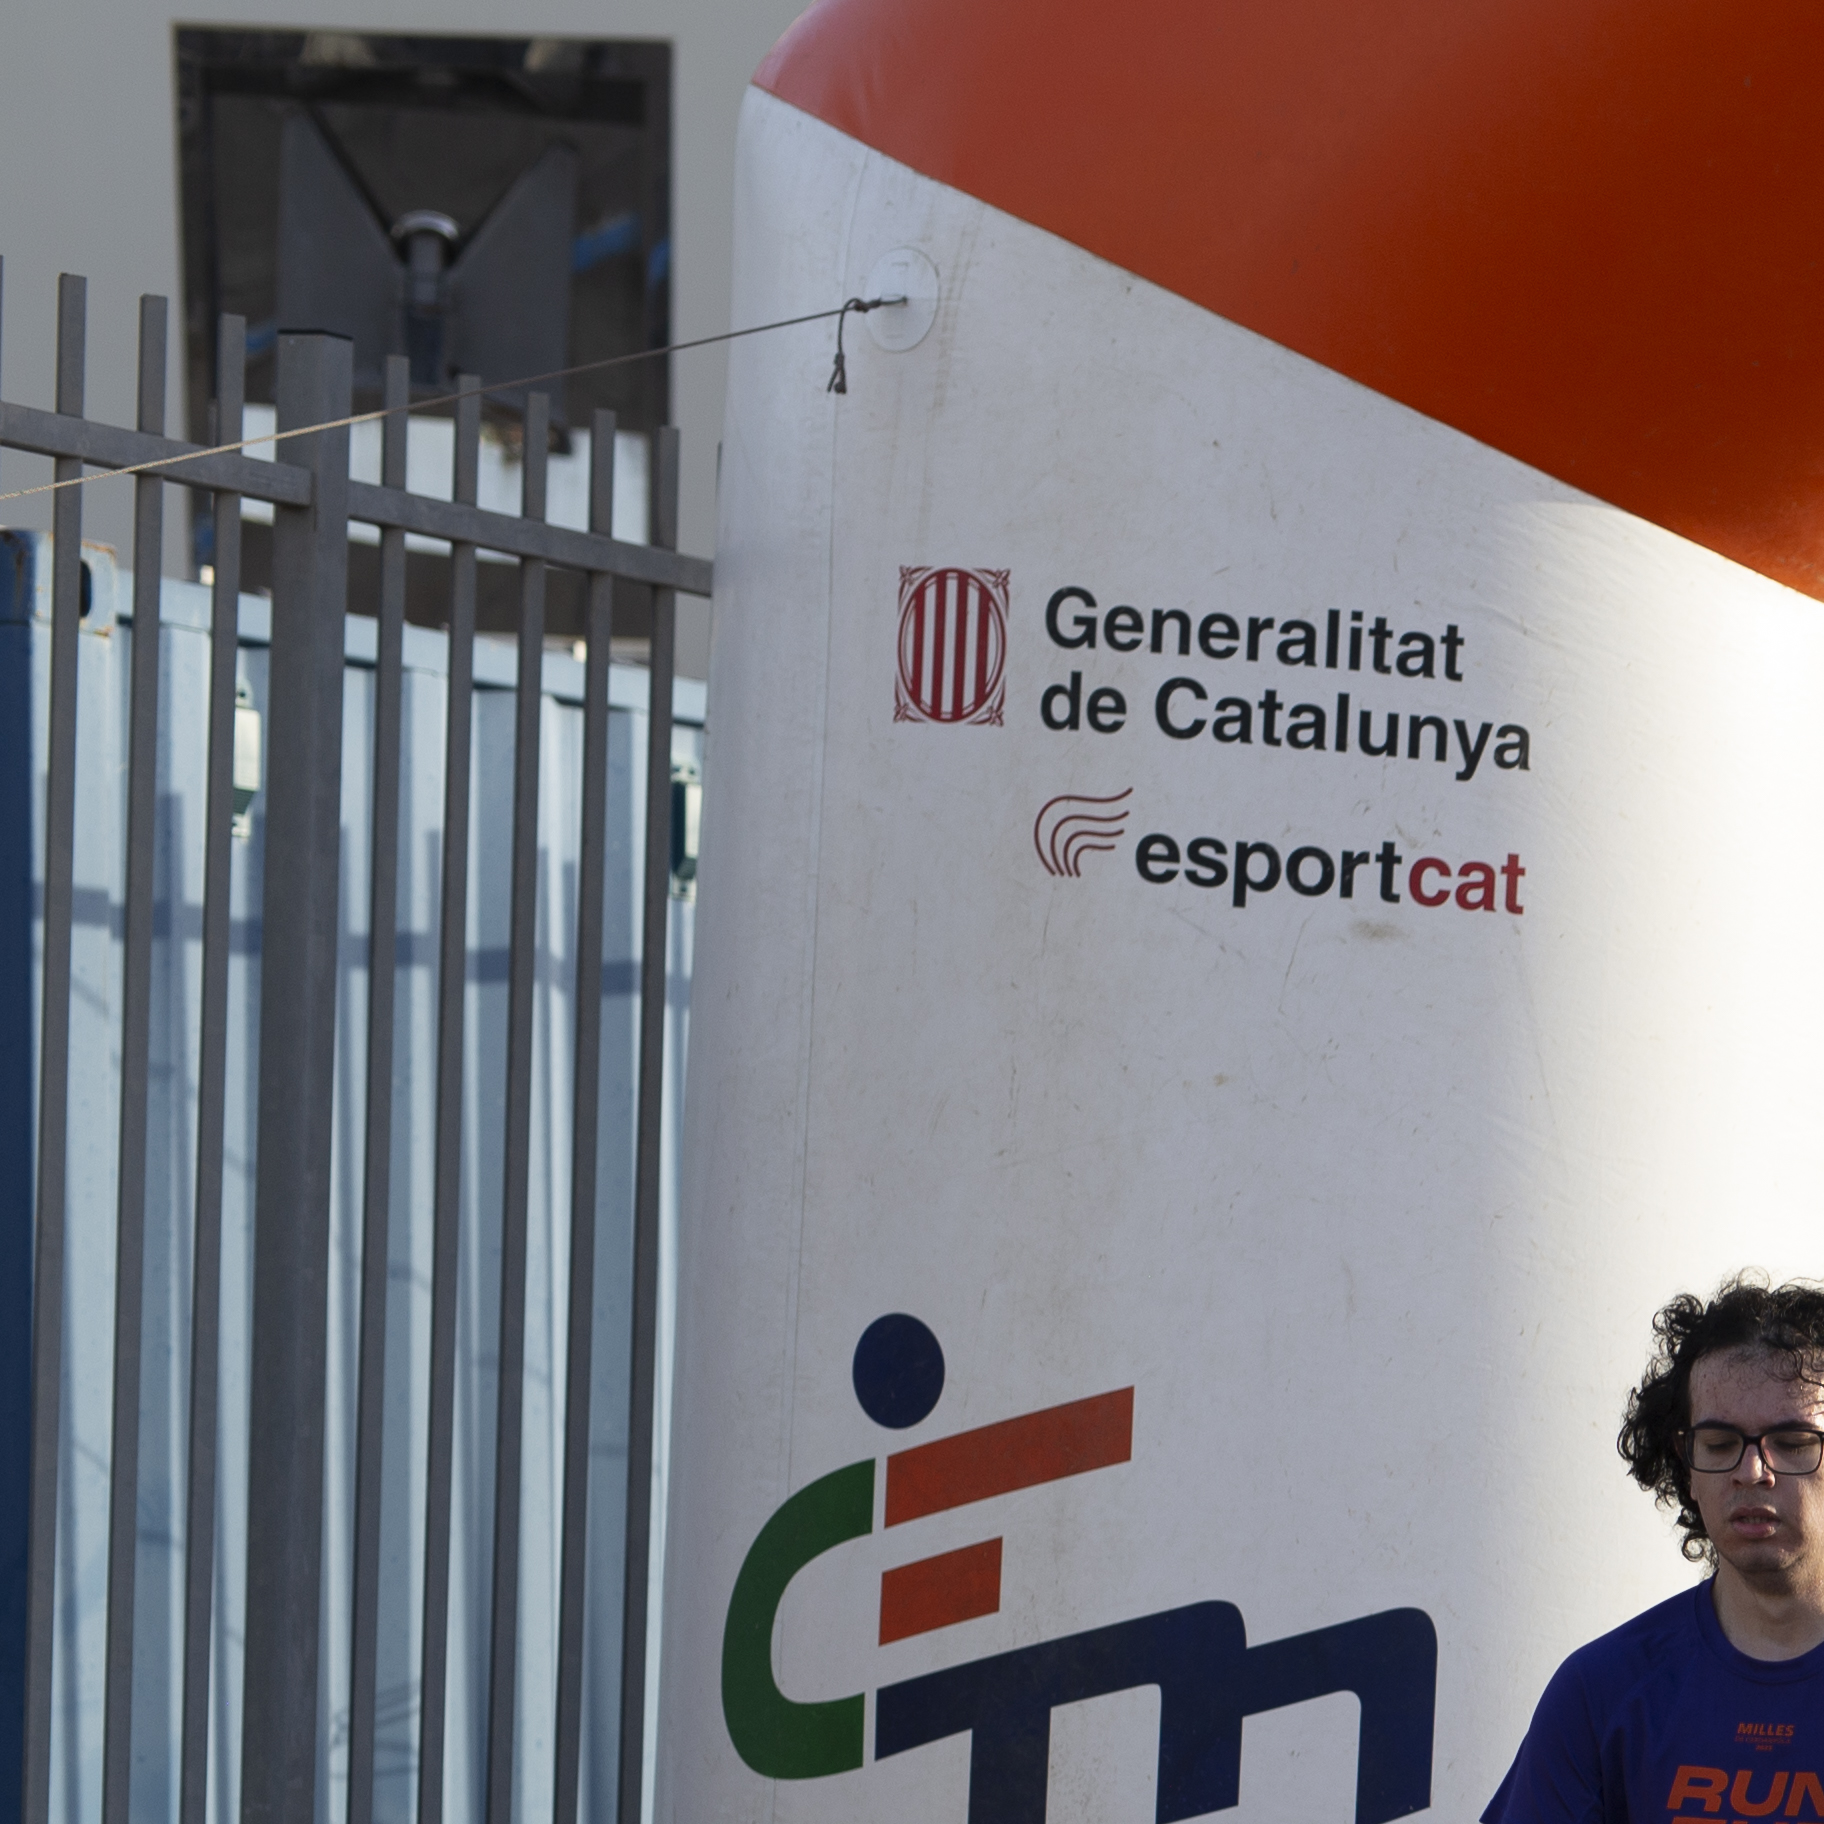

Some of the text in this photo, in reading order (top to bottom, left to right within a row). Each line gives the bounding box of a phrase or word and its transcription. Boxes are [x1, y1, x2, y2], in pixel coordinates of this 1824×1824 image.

[1044, 586, 1466, 682] Generalitat
[1040, 671, 1531, 781] de Catalunya
[1135, 832, 1526, 915] esportcat
[1737, 1722, 1796, 1737] MILLES
